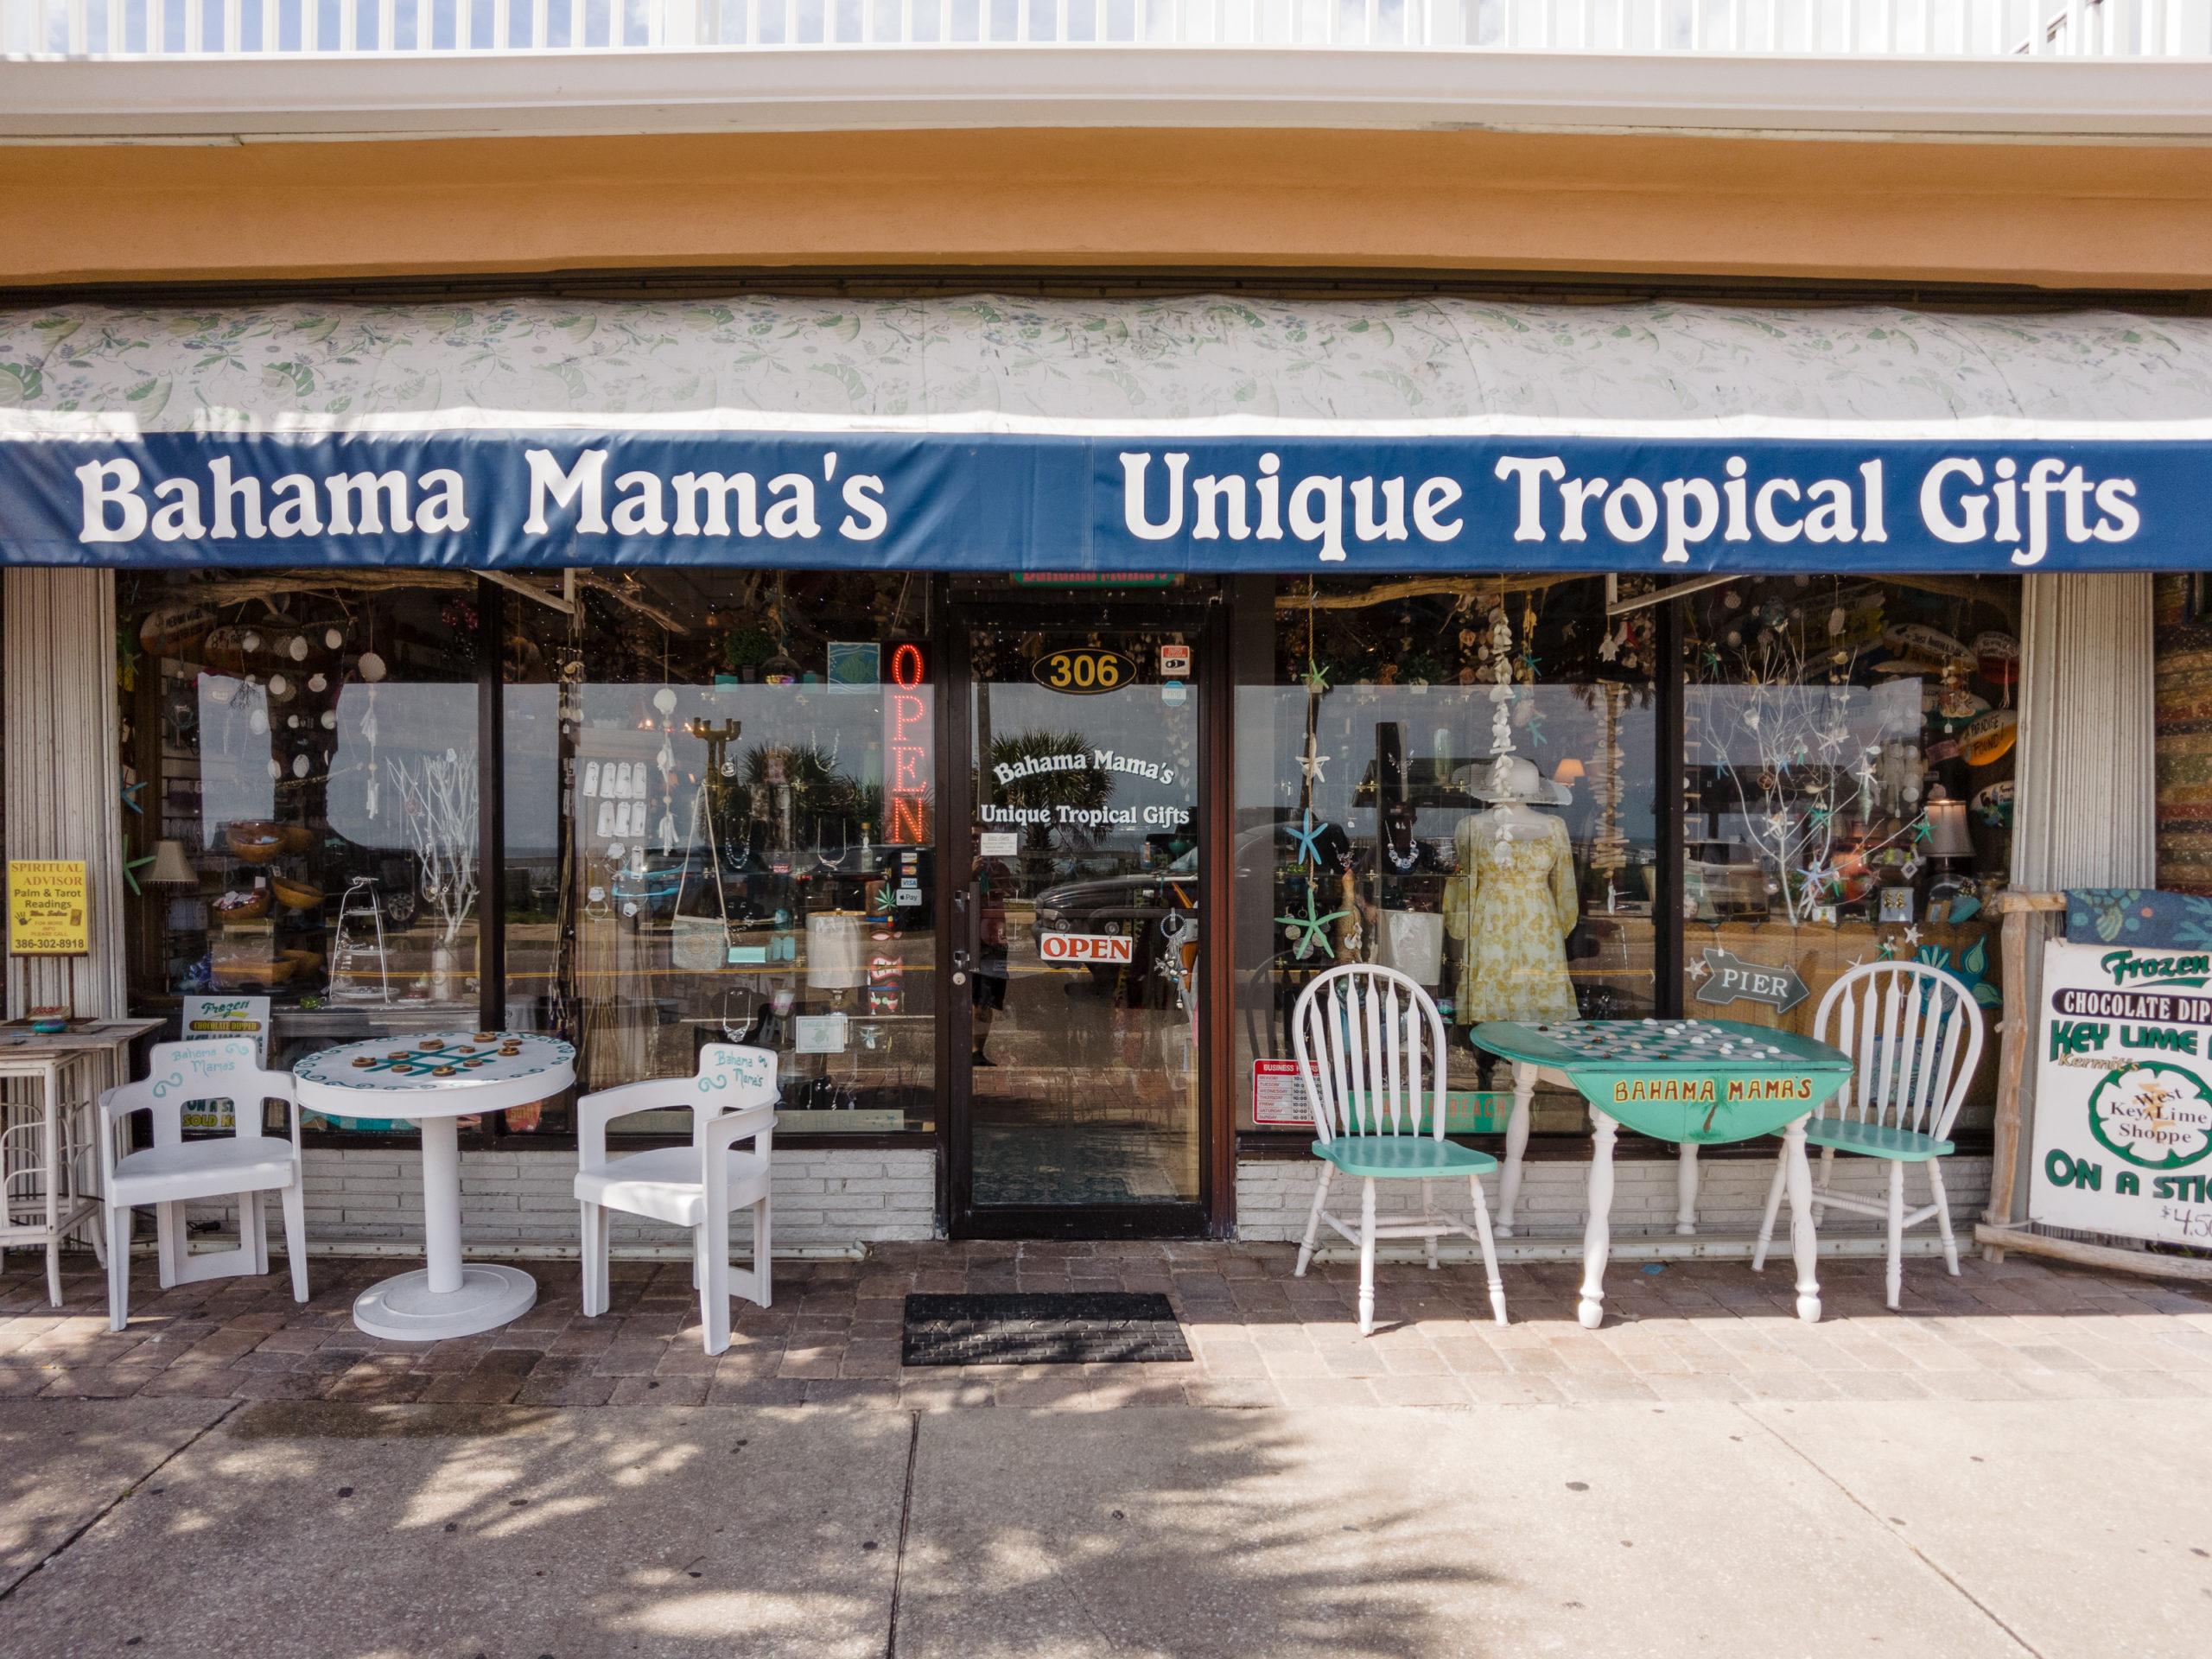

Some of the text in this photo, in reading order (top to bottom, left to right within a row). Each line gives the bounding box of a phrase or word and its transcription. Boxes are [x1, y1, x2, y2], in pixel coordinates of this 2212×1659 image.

[75, 449, 2139, 565] Bahama Mama's Unique Tropical Gifts
[1051, 655, 1118, 687] 306
[891, 644, 926, 844] OPEN
[993, 750, 1174, 785] Bahama Mama's
[981, 804, 1190, 828] Unique Tropical Gifts
[11, 863, 83, 873] SPIRITUAL
[22, 876, 83, 886] ADVISOR
[14, 888, 81, 897] Palm & Tarot
[25, 899, 72, 910] Readings
[16, 939, 84, 949] 386-302-8918
[1043, 938, 1131, 960] OPEN
[2101, 950, 2210, 986] Frozen
[1722, 969, 1789, 998] PIER
[201, 1001, 250, 1019] Frozen
[2063, 991, 2212, 1023] CHOCOLATE DIP
[2050, 1020, 2110, 1062] KEY
[2120, 1025, 2198, 1056] LIME
[714, 1050, 753, 1067] Bahama
[2058, 1052, 2139, 1071] Kermit's
[733, 1068, 764, 1089] Mama's
[1614, 1076, 1813, 1103] BAHAMA MAMA'S
[210, 1100, 218, 1112] A
[1449, 1098, 1505, 1117] BEACH
[2134, 1087, 2182, 1106] West
[183, 1113, 218, 1127] SOLD
[2110, 1102, 2208, 1125] Key Lime
[2119, 1122, 2192, 1145] Shoppe
[2045, 1148, 2212, 1204] ON A STI
